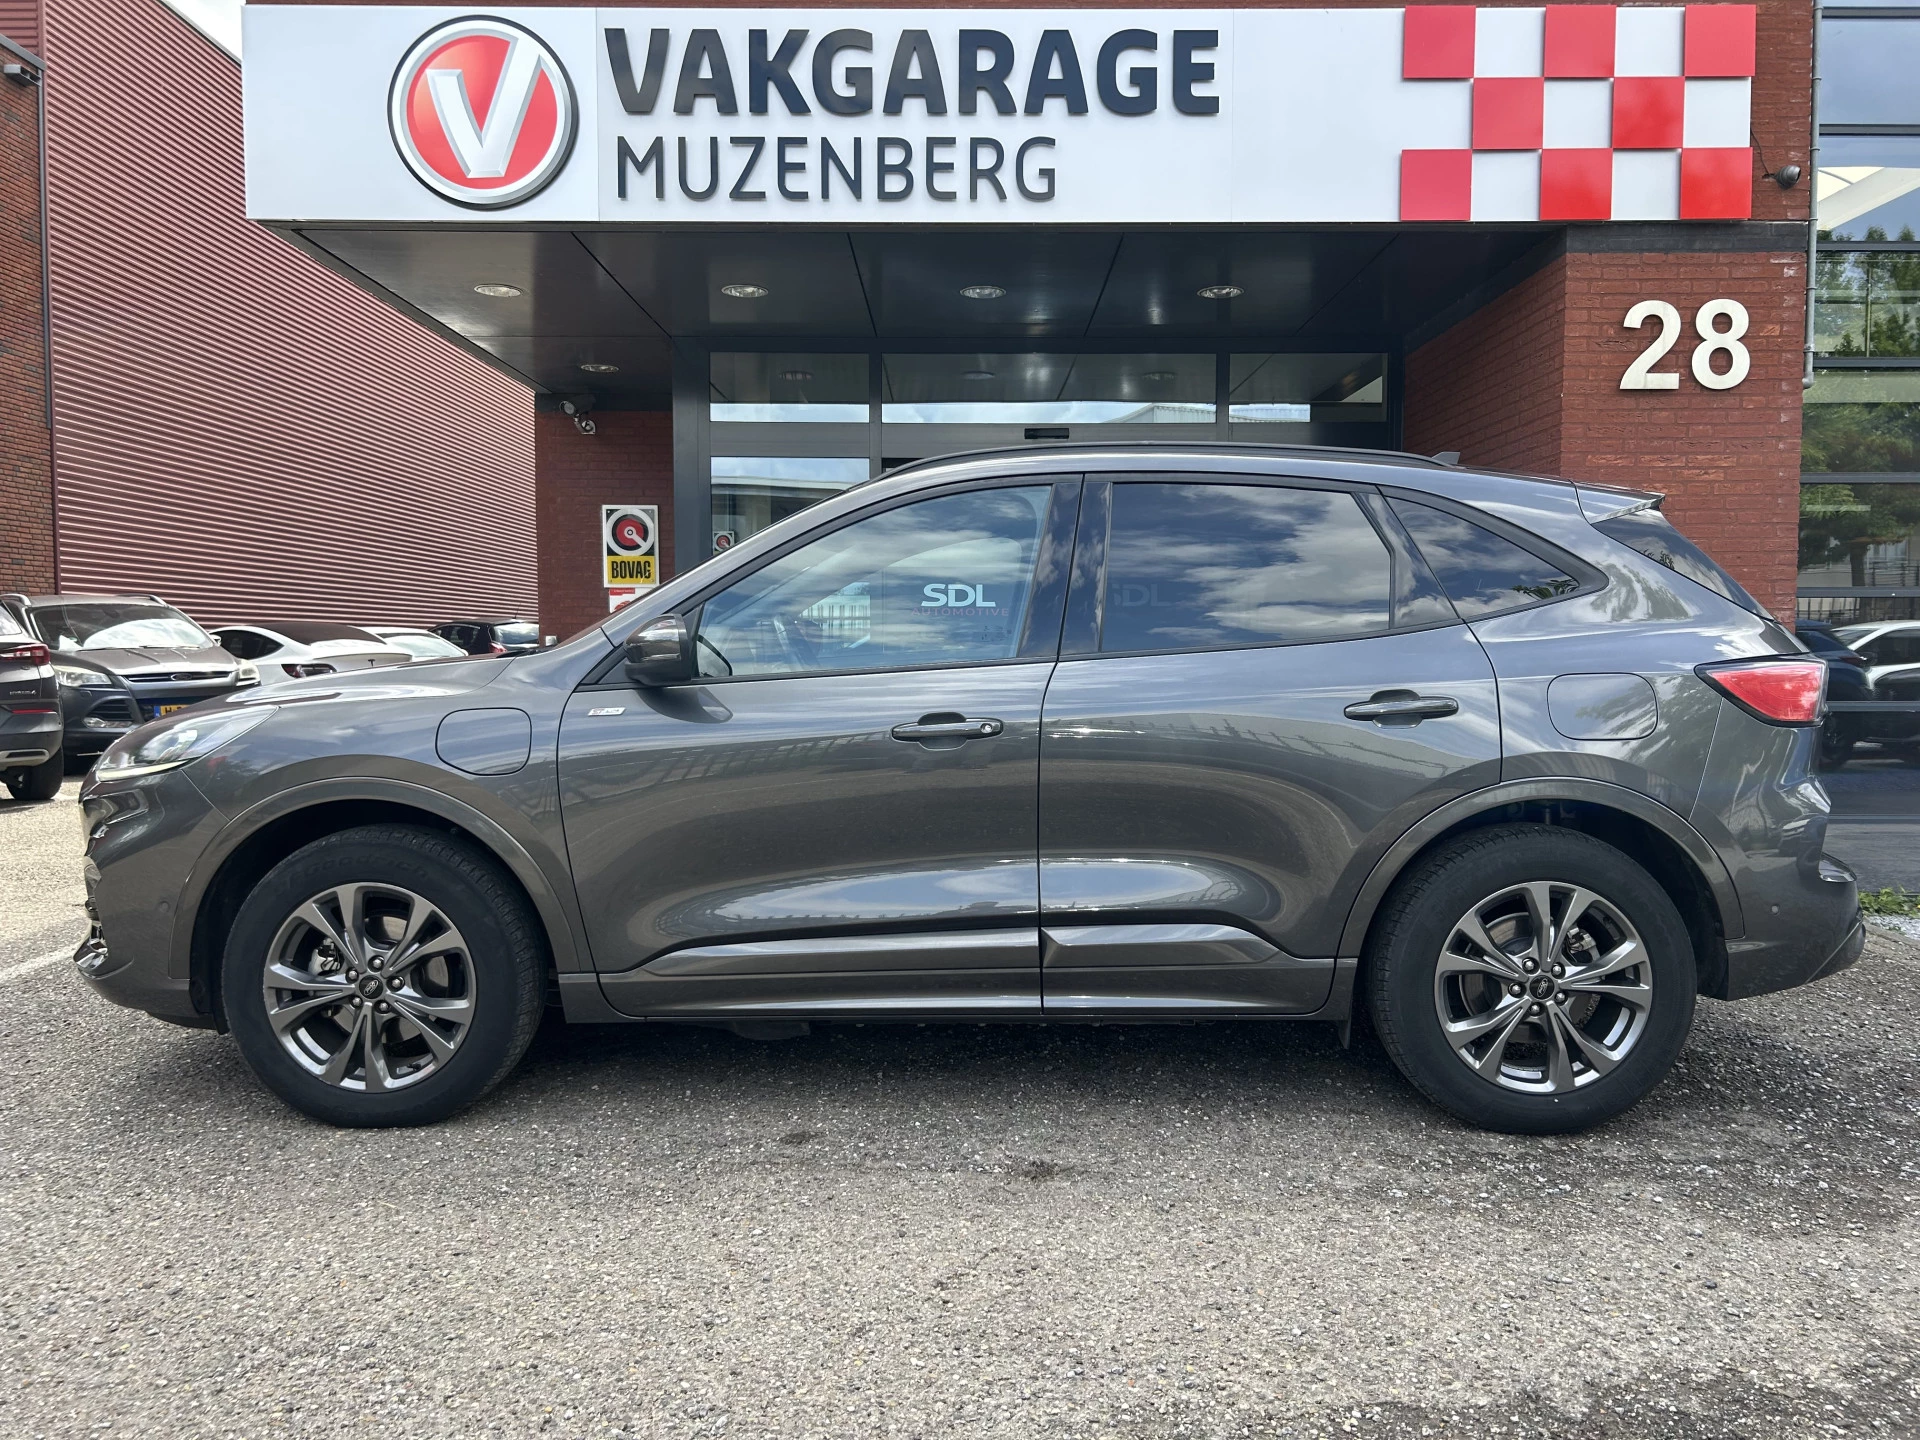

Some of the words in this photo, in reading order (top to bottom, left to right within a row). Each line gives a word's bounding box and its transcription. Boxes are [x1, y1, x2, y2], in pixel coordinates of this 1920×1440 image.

[604, 28, 1220, 115] VAKGARAGE
[616, 135, 1057, 201] MUZENBERG
[1619, 298, 1751, 390] 28
[611, 560, 652, 579] BOVAG
[910, 607, 1010, 617] AUTOMOTIVE
[920, 583, 997, 607] SDL
